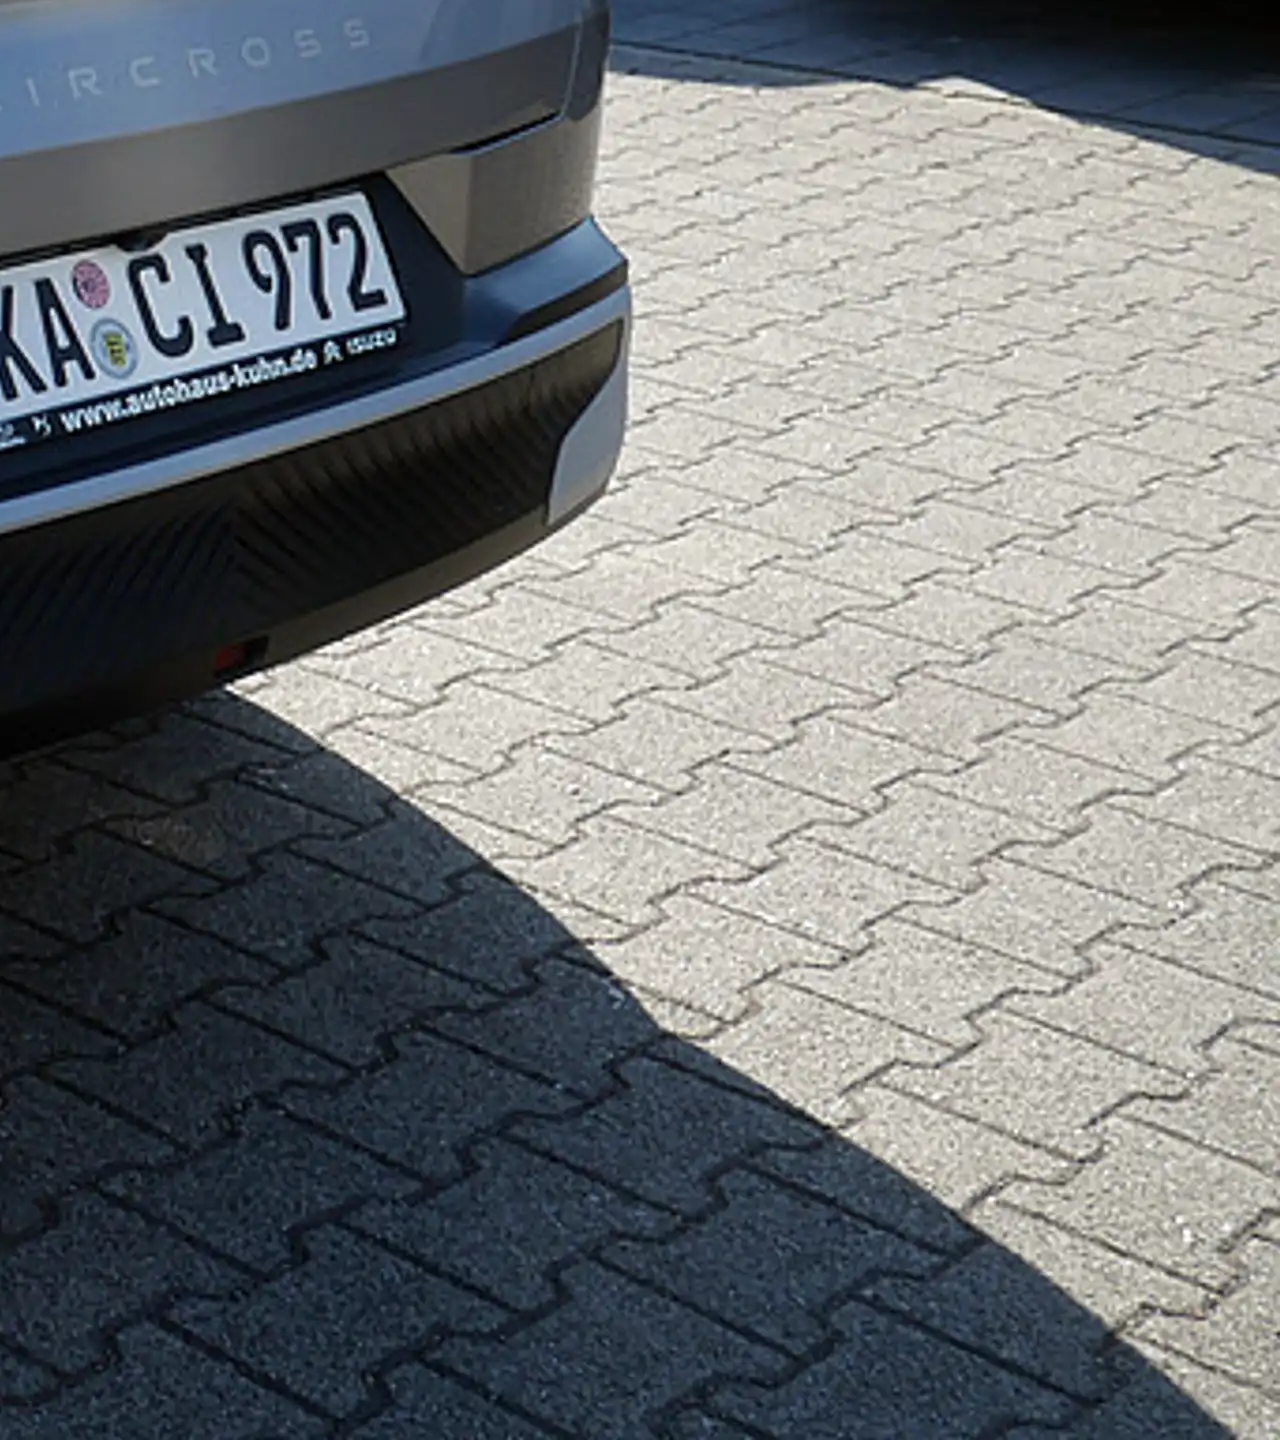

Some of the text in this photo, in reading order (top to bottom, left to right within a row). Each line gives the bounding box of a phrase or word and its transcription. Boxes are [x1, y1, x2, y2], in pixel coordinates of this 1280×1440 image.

[126, 242, 247, 358] CI
[241, 212, 389, 332] 972
[60, 346, 318, 435] www.autohaus-kuhn.de
